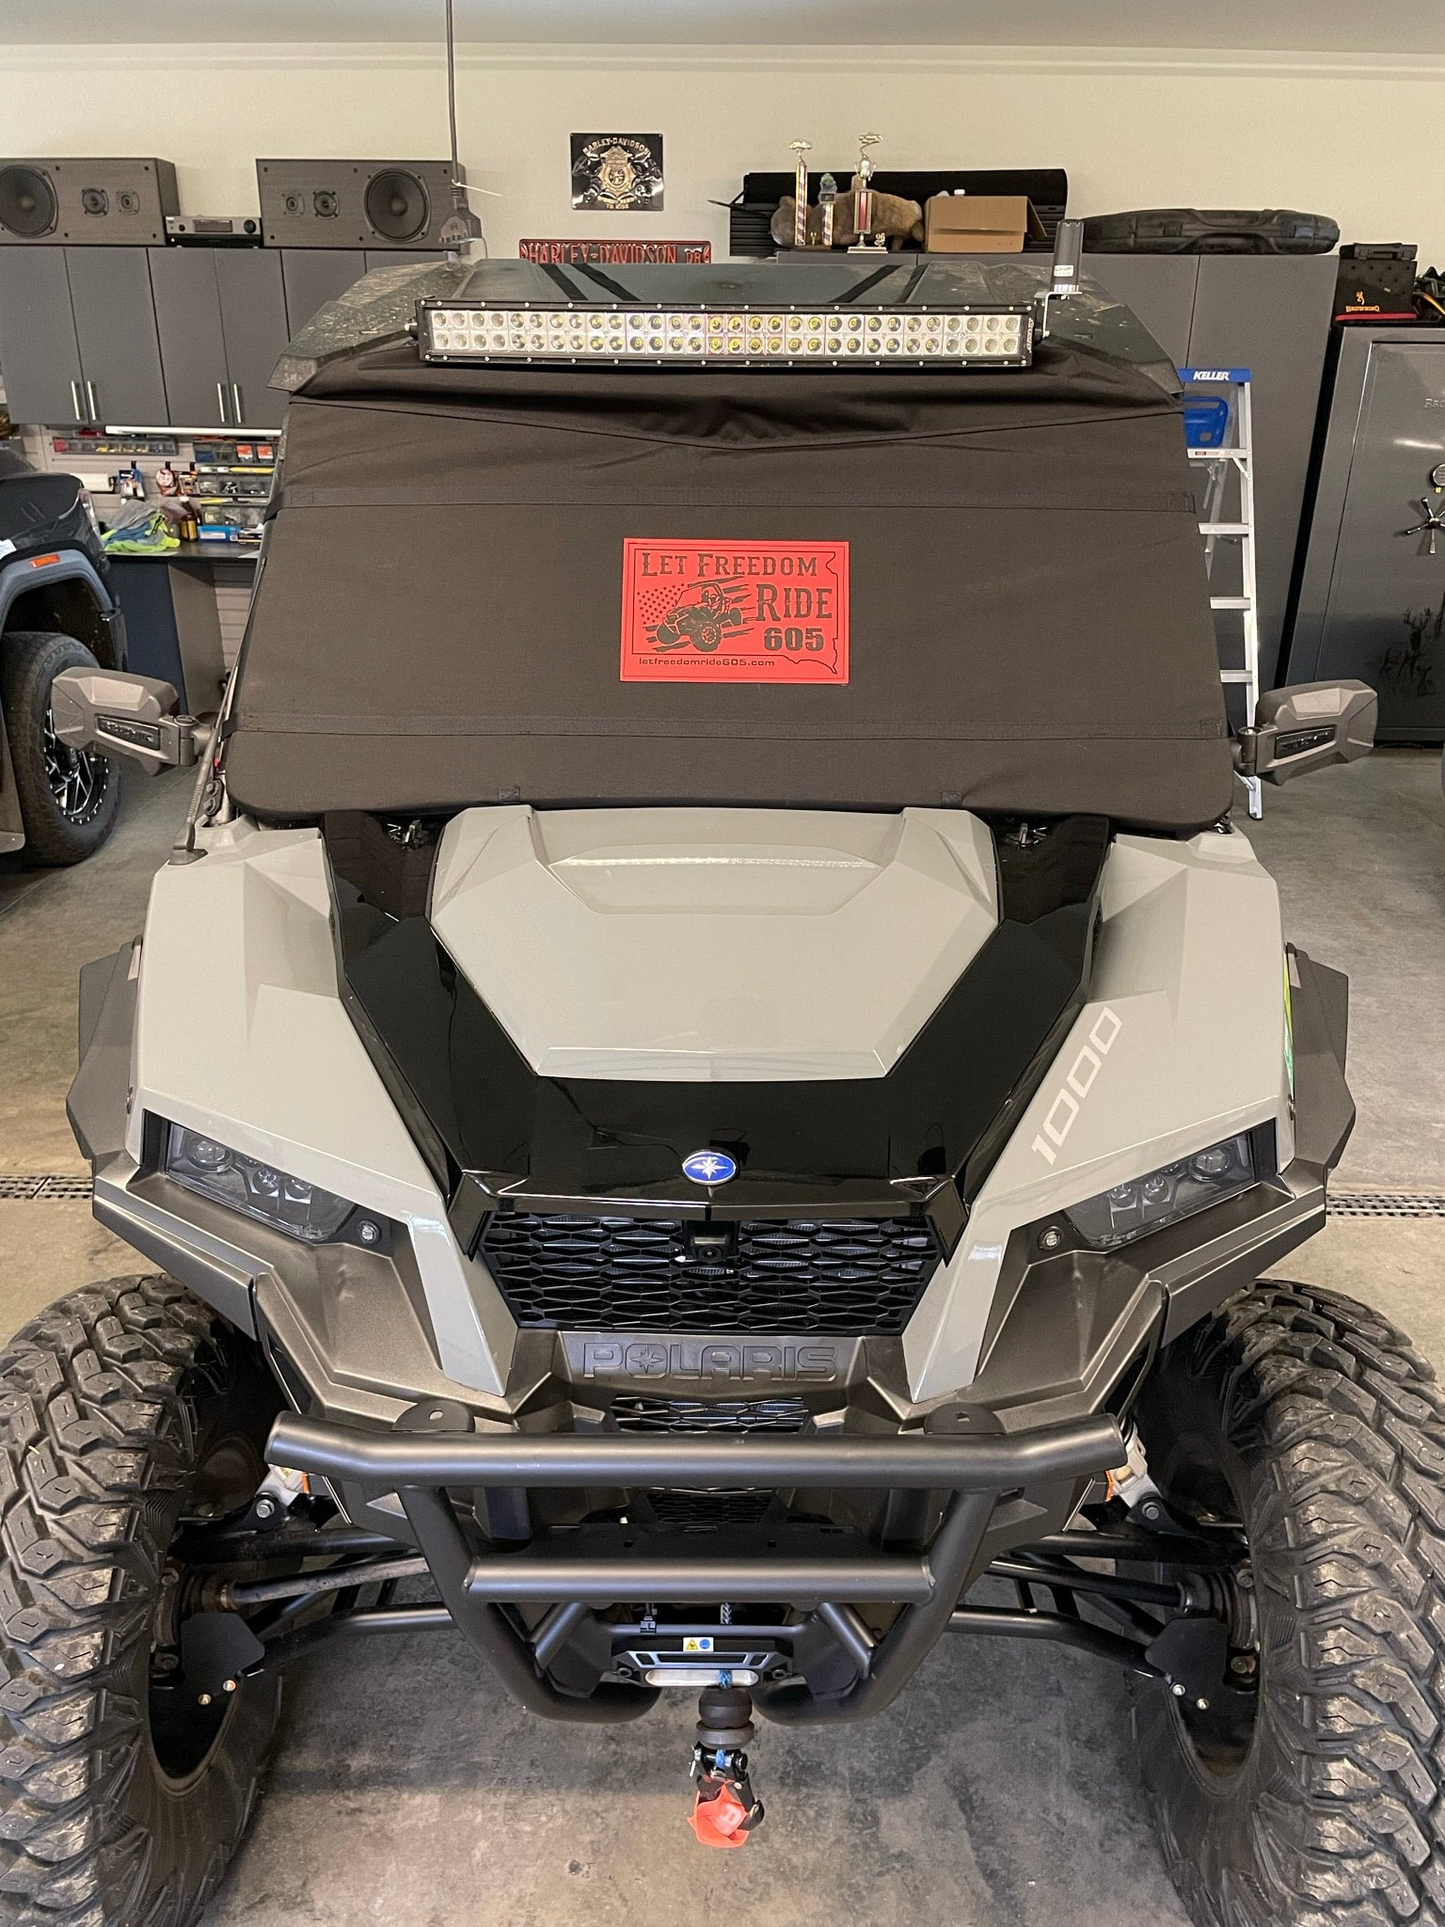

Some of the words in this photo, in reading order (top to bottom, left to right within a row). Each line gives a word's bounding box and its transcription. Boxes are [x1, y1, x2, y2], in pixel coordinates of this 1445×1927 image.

[1193, 371, 1230, 381] KELLER
[641, 552, 688, 577] LET
[697, 553, 817, 577] FREEDOM
[756, 583, 832, 622] RIDE
[763, 627, 824, 651] 605
[639, 657, 775, 667] letfreedomride605.com
[1031, 1006, 1122, 1165] 1000
[583, 1342, 837, 1382] POLARIS
